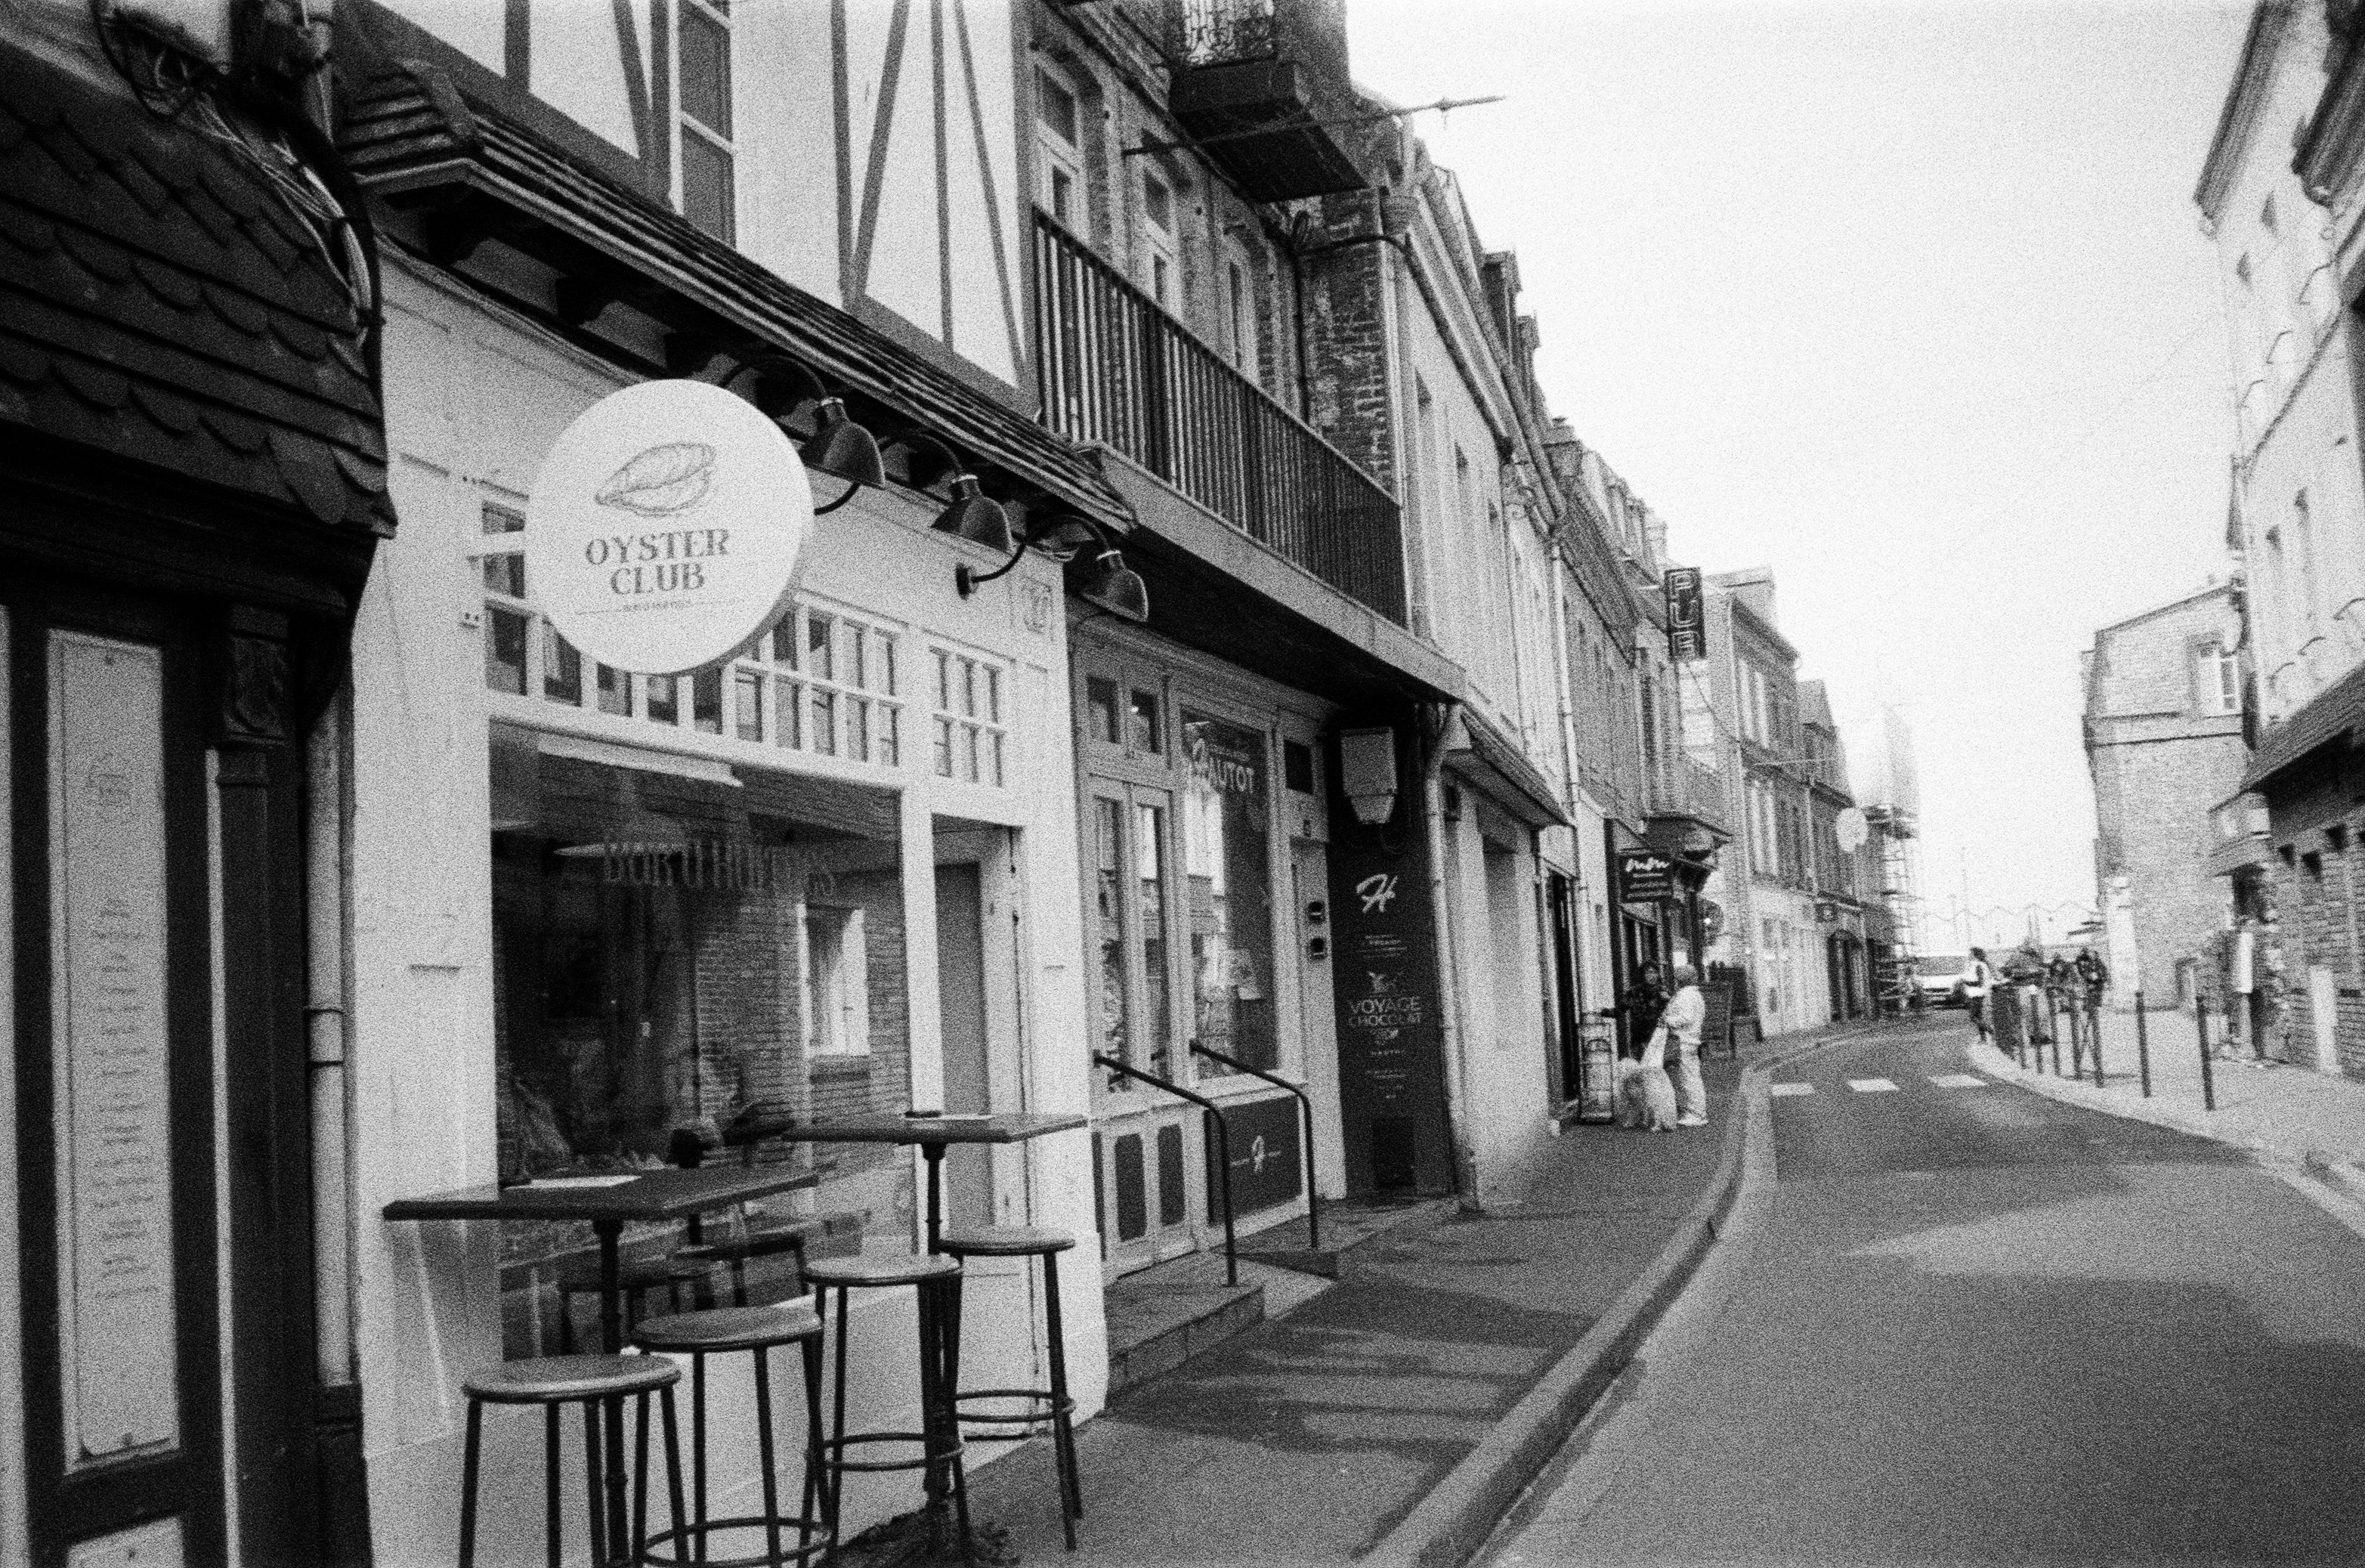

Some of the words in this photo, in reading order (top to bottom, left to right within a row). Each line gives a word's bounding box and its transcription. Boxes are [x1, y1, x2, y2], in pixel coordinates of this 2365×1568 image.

[585, 528, 730, 565] OYSTER
[609, 562, 706, 595] CLUB
[1668, 570, 1701, 658] PUB
[1347, 995, 1422, 1015] VOYAGE
[1348, 1012, 1423, 1028] CHOCOLAT
